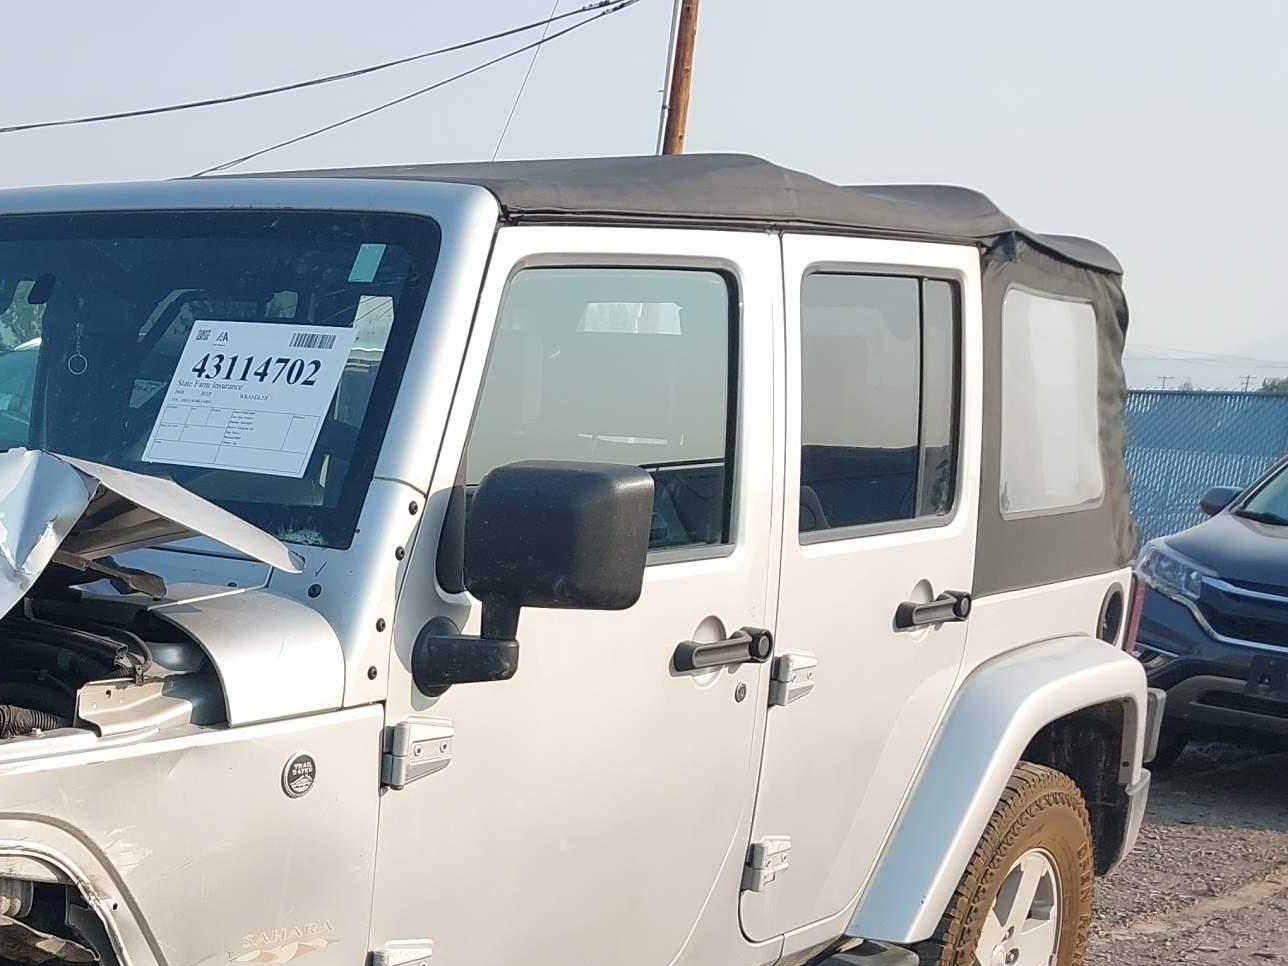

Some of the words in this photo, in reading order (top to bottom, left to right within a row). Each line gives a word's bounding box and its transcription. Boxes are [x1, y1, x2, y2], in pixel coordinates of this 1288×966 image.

[176, 378, 193, 387] State
[194, 380, 211, 389] Farm
[212, 381, 244, 391] Insurance
[191, 353, 322, 386] 43114702
[241, 918, 335, 948] SAHARA
